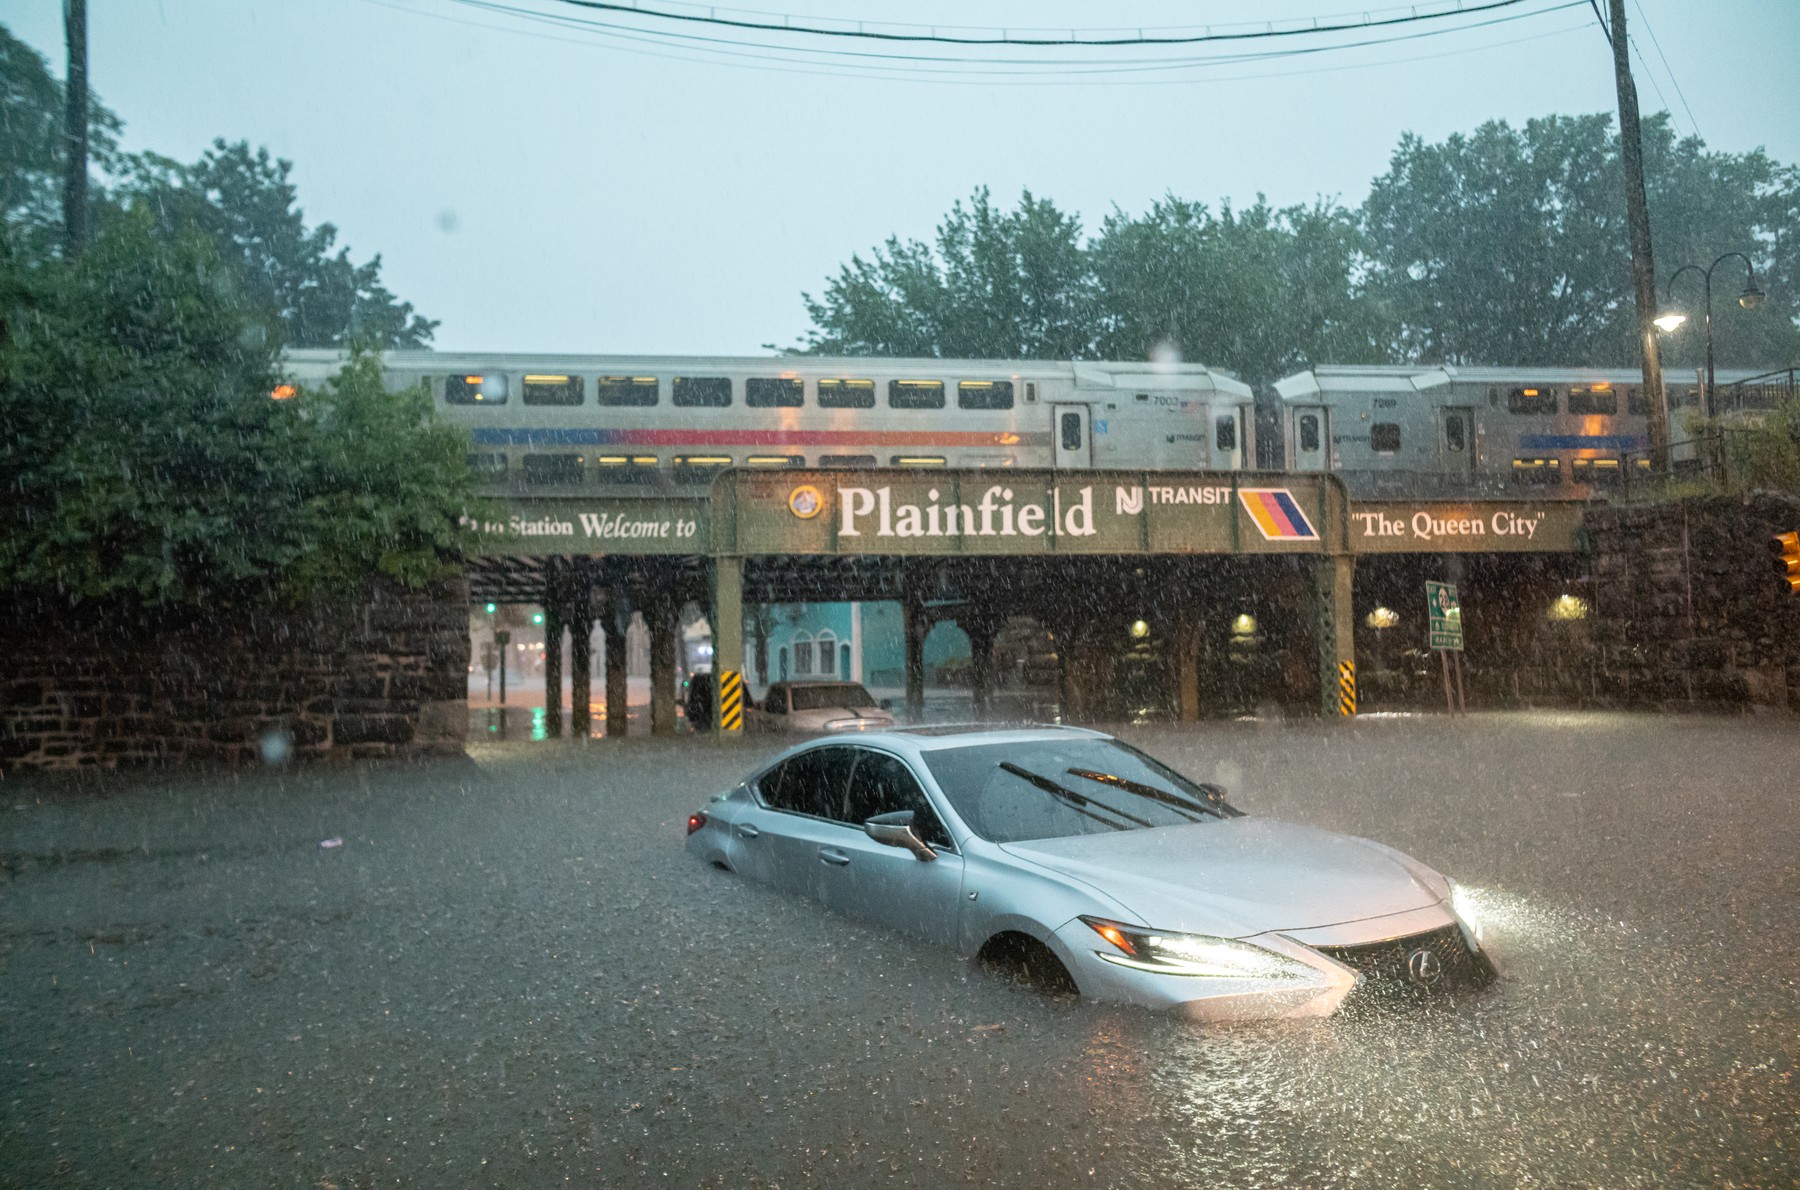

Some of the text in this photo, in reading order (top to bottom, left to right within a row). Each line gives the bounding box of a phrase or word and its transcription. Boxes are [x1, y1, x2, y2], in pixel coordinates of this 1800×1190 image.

[837, 485, 1098, 538] Plainfield
[1115, 486, 1233, 515] NJ TRANSIT
[509, 515, 574, 536] Station
[578, 512, 697, 538] Welcome to
[1351, 511, 1545, 541] "The Queen City"
